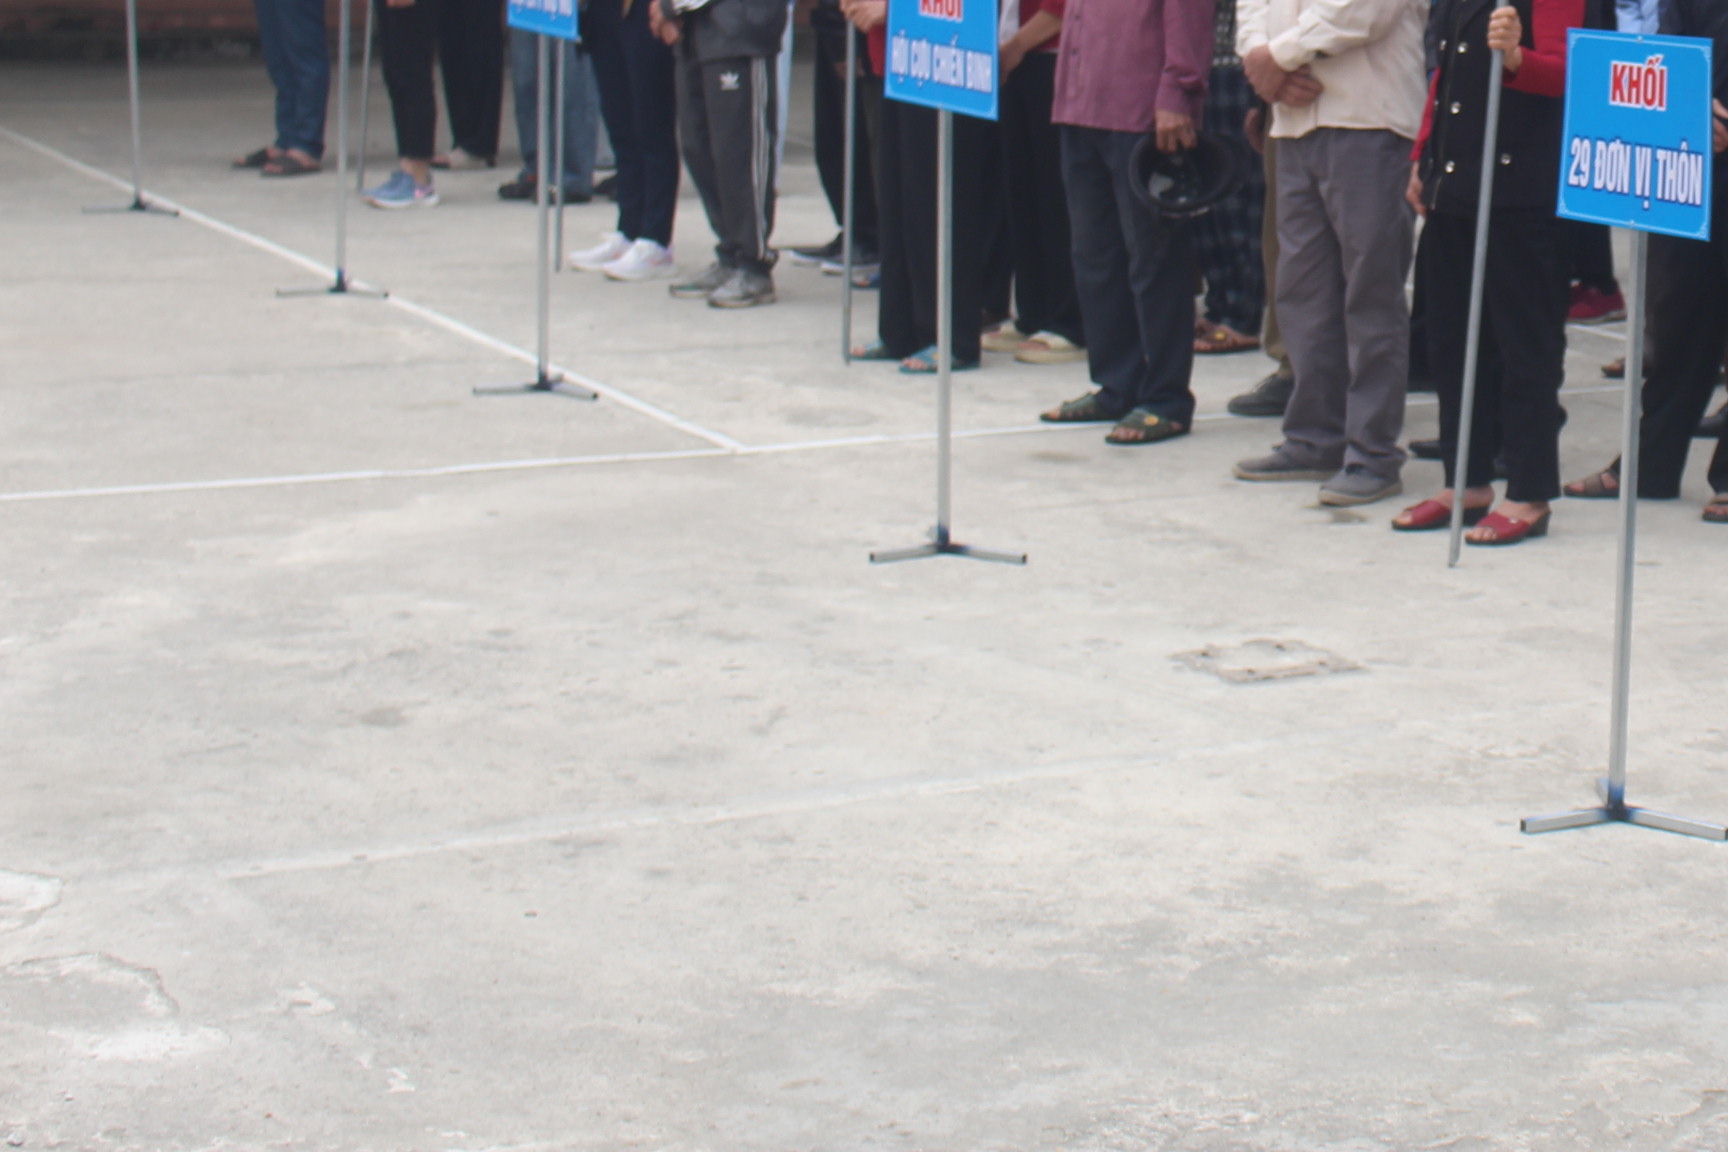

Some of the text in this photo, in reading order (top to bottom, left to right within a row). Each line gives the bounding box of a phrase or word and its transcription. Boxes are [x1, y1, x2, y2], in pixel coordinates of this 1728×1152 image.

[1609, 54, 1668, 111] KHỐI
[1567, 136, 1704, 210] 29 ĐƠN VỊ THÔN
